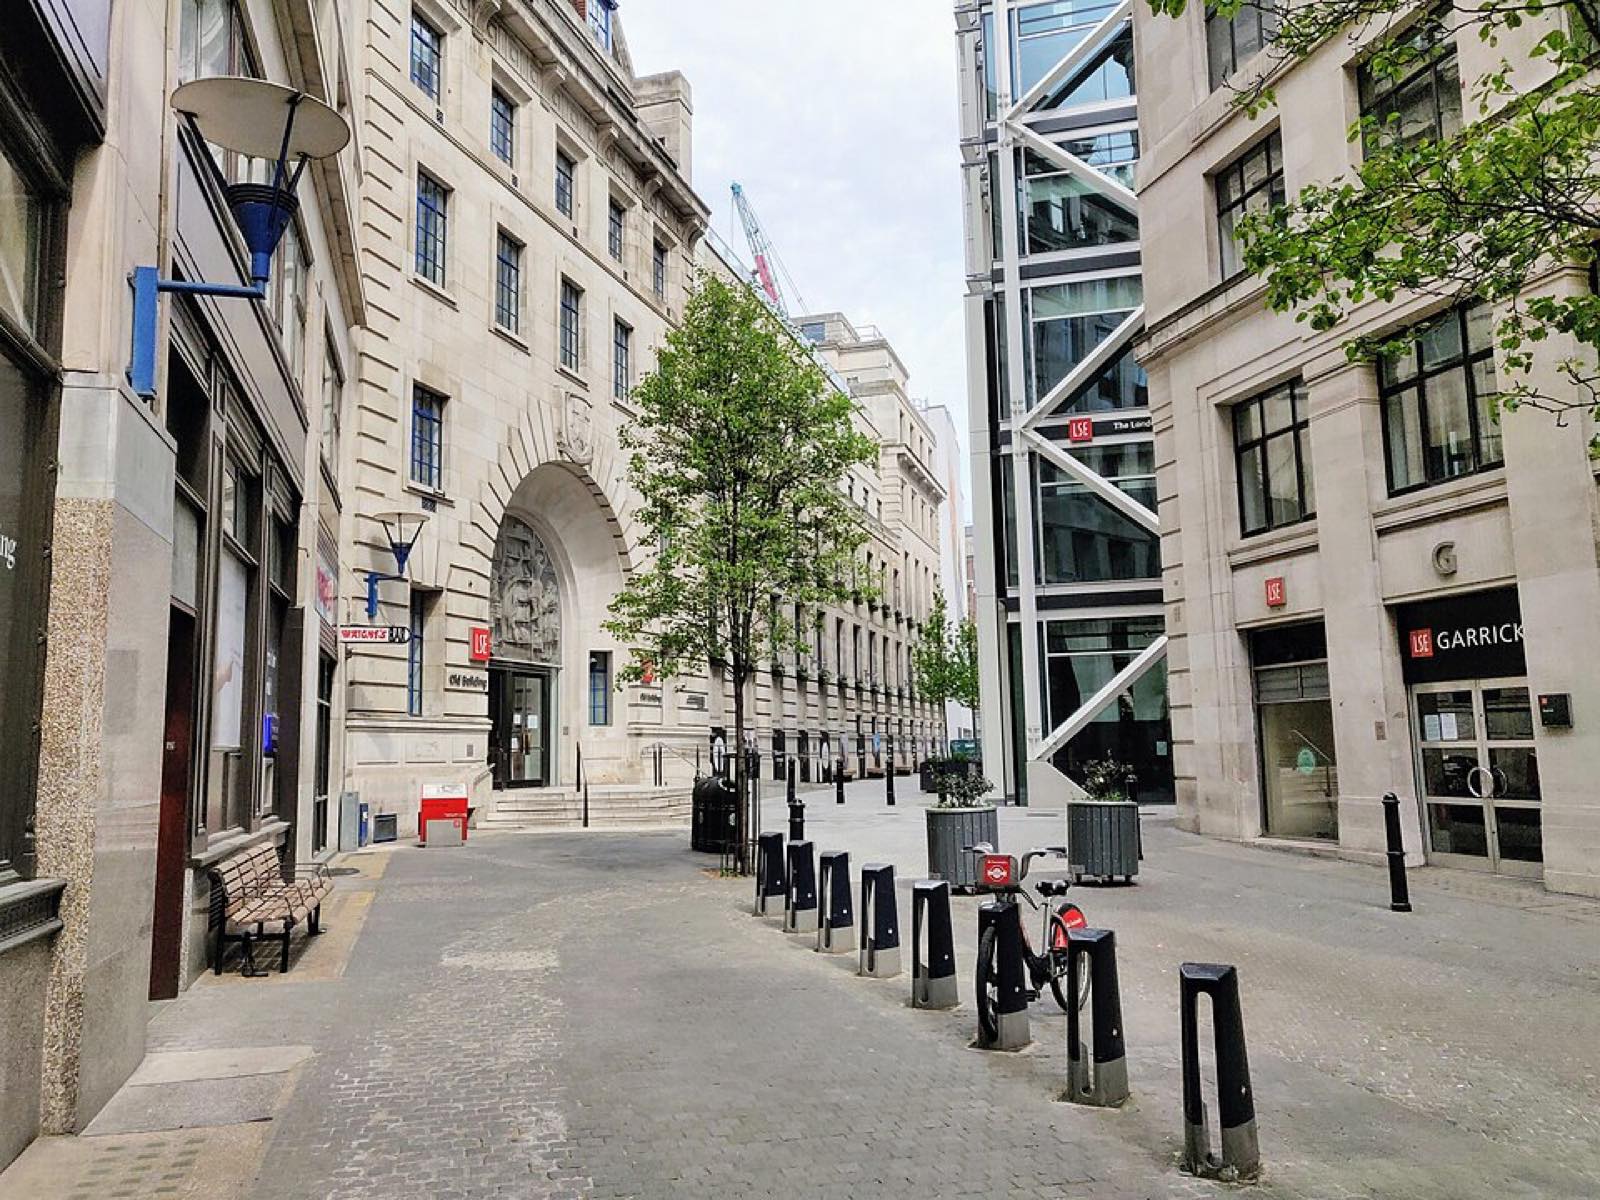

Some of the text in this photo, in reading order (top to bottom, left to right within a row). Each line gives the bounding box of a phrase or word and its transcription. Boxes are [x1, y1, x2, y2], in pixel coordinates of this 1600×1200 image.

[1072, 421, 1089, 438] LSE
[1113, 421, 1129, 430] The
[1431, 541, 1458, 578] G
[1267, 582, 1281, 601] LSE
[1412, 622, 1524, 654] LSE GARRICK
[449, 673, 461, 686] Old
